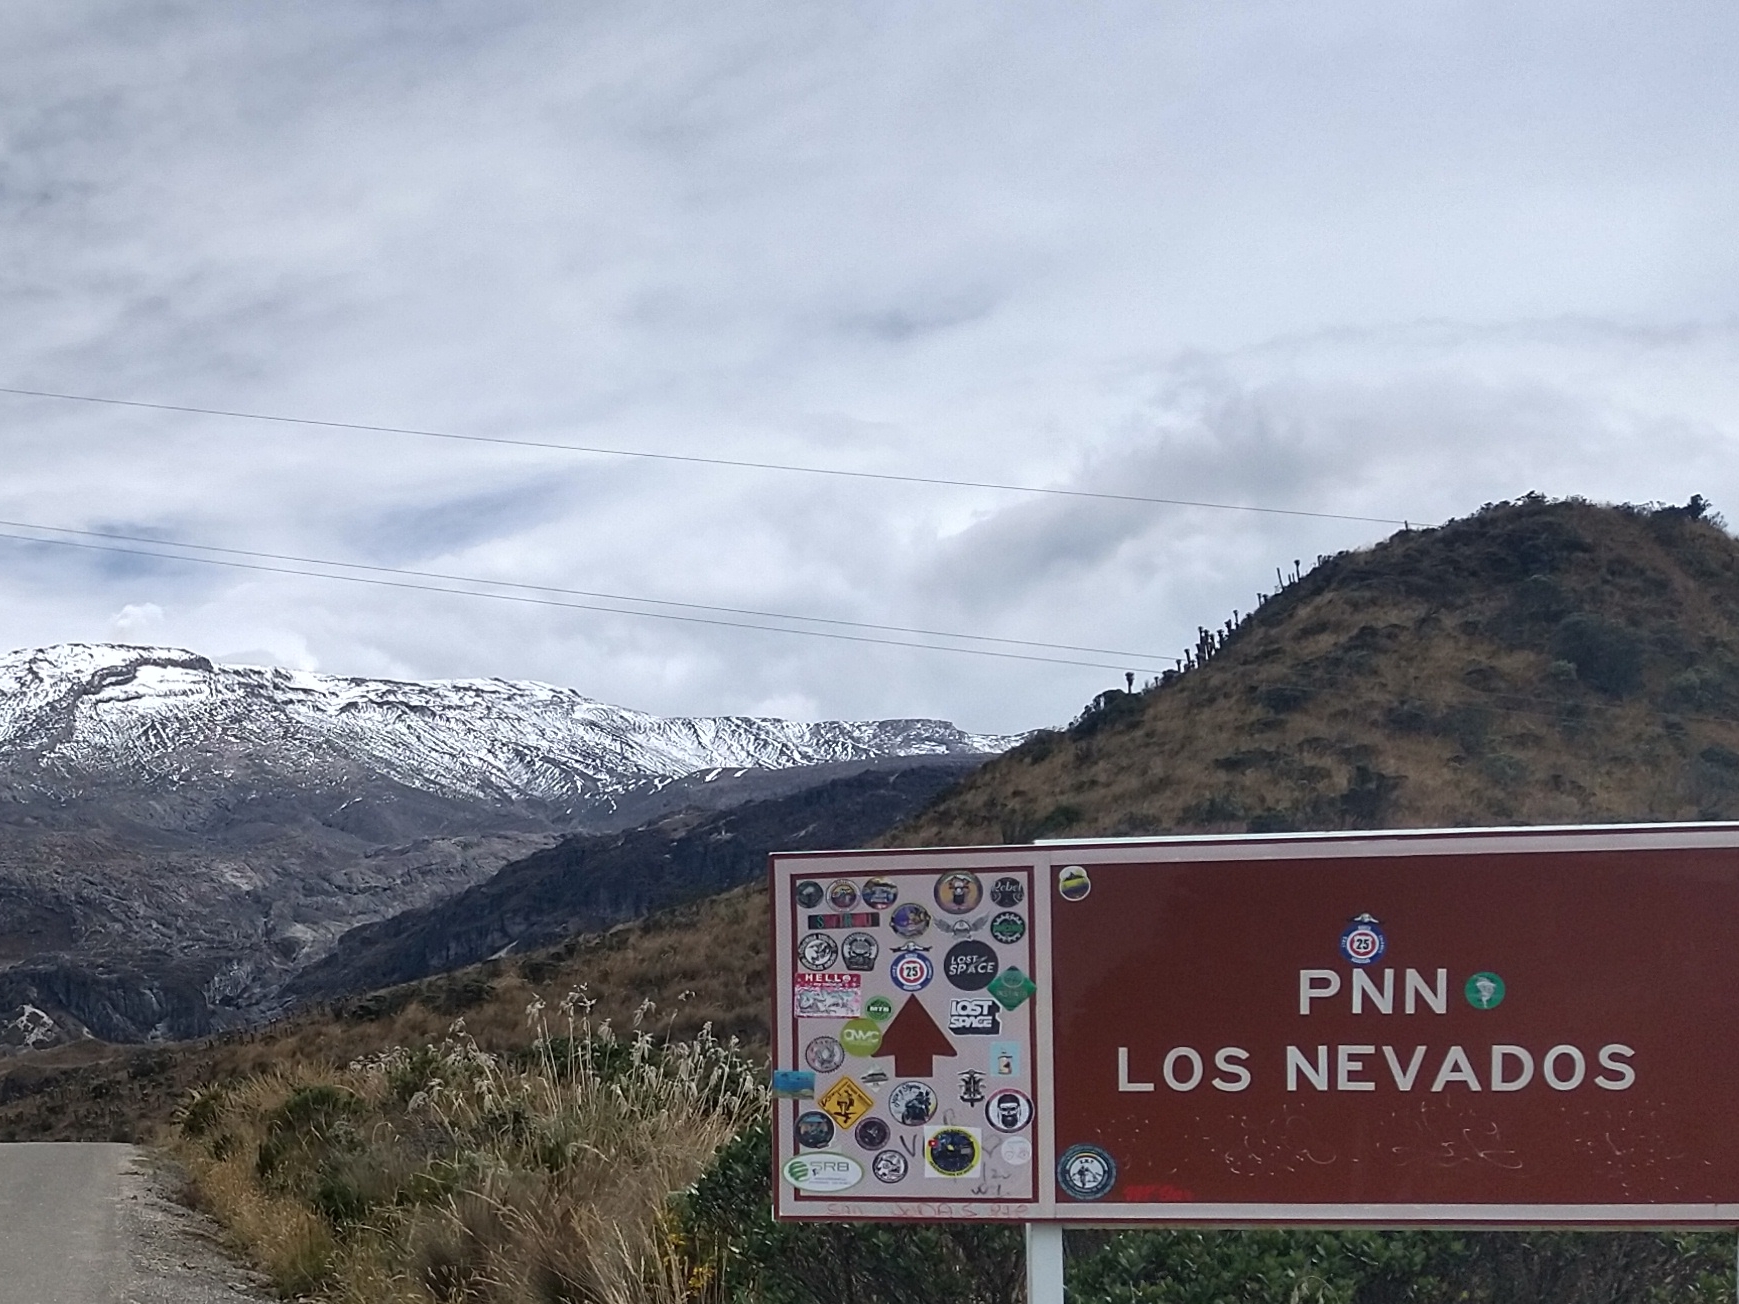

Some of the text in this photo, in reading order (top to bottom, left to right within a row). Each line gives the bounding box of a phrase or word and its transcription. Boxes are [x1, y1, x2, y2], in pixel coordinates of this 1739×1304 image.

[1355, 938, 1370, 950] 25
[950, 955, 979, 965] LOST
[905, 965, 919, 978] 25
[948, 962, 995, 976] SPACE
[805, 973, 851, 982] HELLO
[1298, 967, 1448, 1015] PNN
[950, 1000, 993, 1015] LOST
[948, 1015, 993, 1028] SPACE
[1116, 1044, 1637, 1092] LOS NEVADOS
